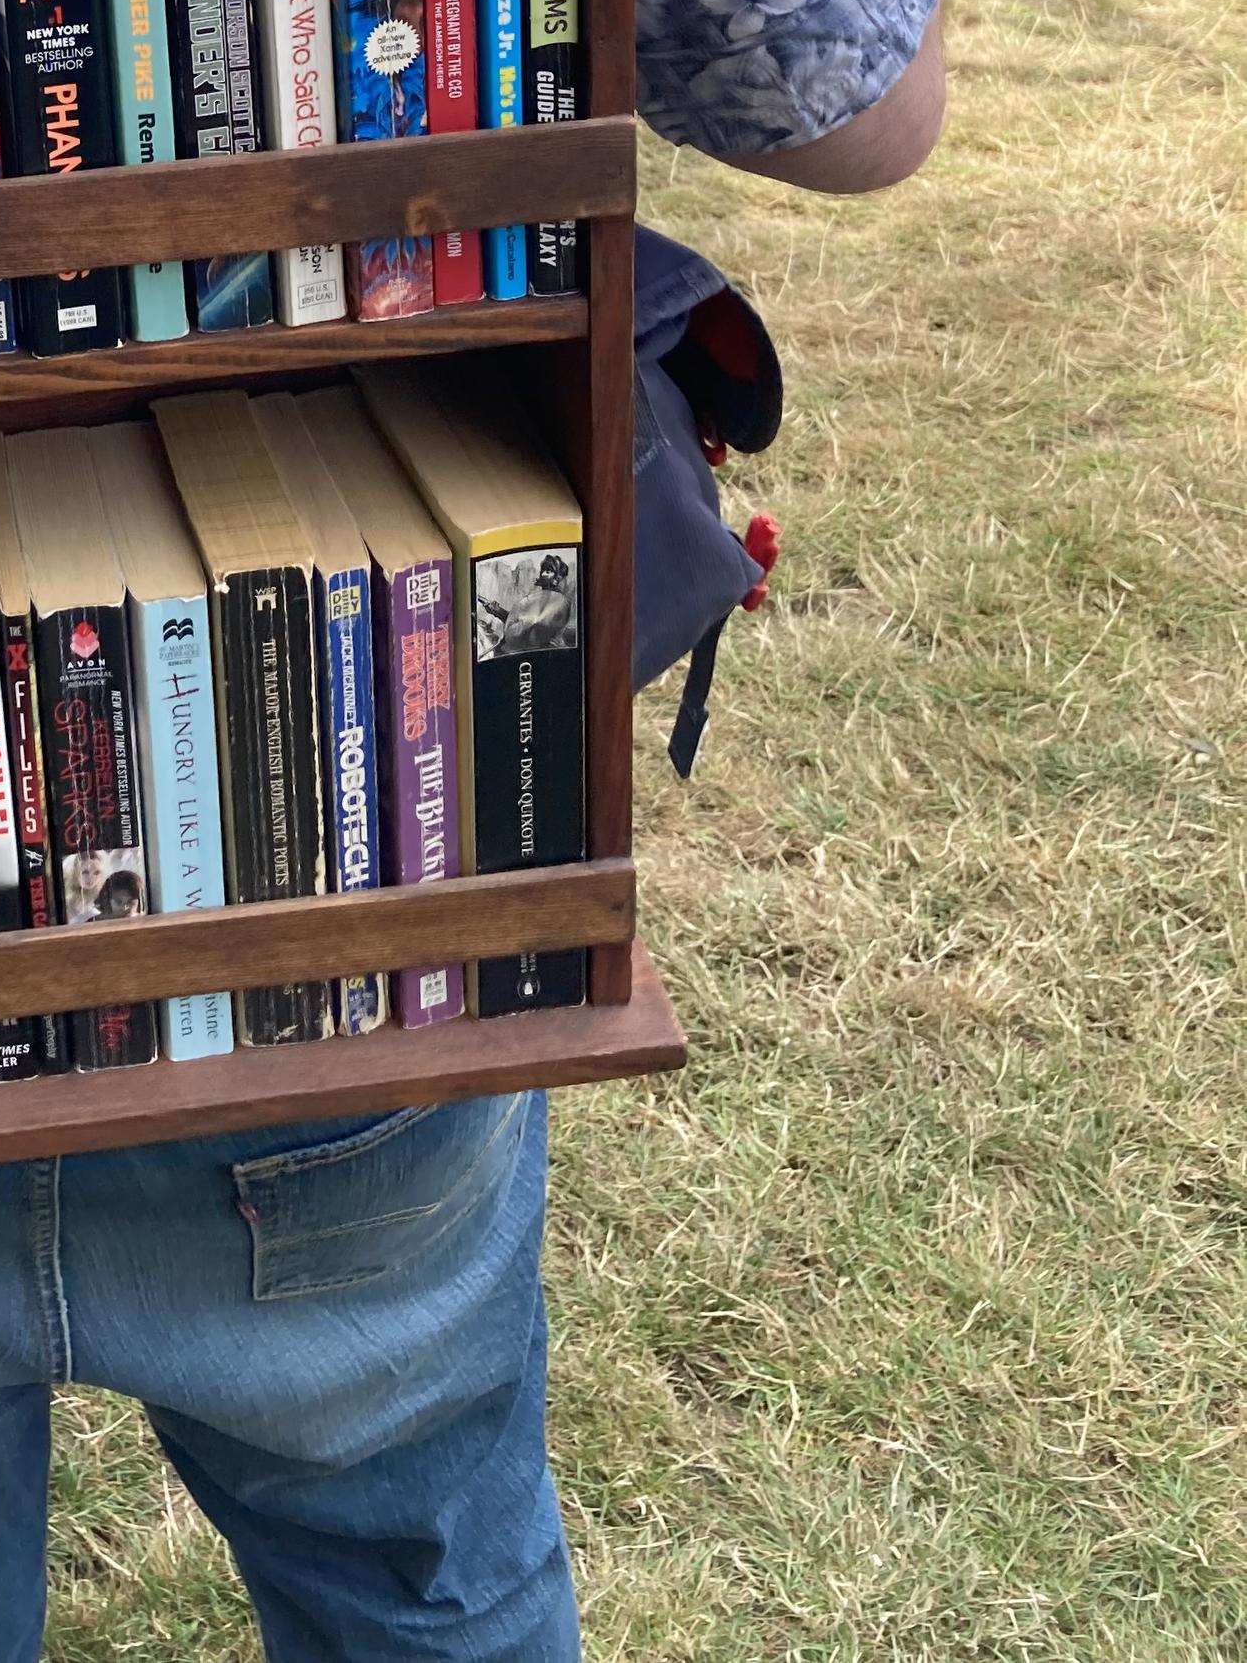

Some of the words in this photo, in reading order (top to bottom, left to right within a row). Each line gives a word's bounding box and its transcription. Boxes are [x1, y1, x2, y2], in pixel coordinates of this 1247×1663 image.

[434, 1, 442, 18] THE
[26, 28, 53, 40] NEW
[57, 24, 89, 35] YORK
[41, 37, 76, 49] TIMES
[292, 7, 316, 66] Who
[377, 33, 405, 44] all-new
[385, 25, 396, 33] An
[435, 20, 443, 62] JAMESON
[25, 47, 94, 64] BESTSELLING
[373, 52, 412, 65] adventure
[380, 44, 403, 53] Xanth
[447, 43, 461, 56] BY
[498, 30, 515, 59] Jr.
[37, 59, 83, 74] AUTHOR
[134, 44, 154, 101] PIKE
[436, 63, 444, 89] HEIRS
[448, 57, 462, 77] THE
[294, 70, 321, 121] Said
[449, 79, 462, 99] CEO
[536, 71, 554, 123] GUIDE
[558, 87, 575, 120] THE
[229, 70, 255, 138] SCOTT
[332, 587, 358, 604] DEL
[409, 575, 438, 593] DEL
[409, 589, 439, 606] REY
[333, 601, 359, 616] REY
[9, 626, 23, 638] THE
[7, 644, 28, 672] X
[67, 658, 106, 669] AVON
[262, 640, 277, 669] THE
[59, 672, 113, 683] PARANORMAL
[263, 670, 280, 714] MAJOR
[401, 634, 428, 742] BROOKS
[111, 690, 122, 707] NEW
[518, 661, 533, 744] CERVANTES
[112, 708, 125, 733] YORK
[161, 673, 200, 786] HUNGRY
[15, 680, 37, 834] FILES
[115, 733, 126, 758] TIMES
[266, 717, 285, 775] ENGLISH
[54, 698, 97, 846] SPARKS
[414, 744, 443, 798] THE
[519, 757, 533, 792] DON
[116, 759, 131, 813] BESTSELLING
[268, 778, 288, 846] ROMANTIC
[338, 725, 370, 887] ROBOTECH
[121, 814, 132, 846] AUTHOR
[178, 798, 199, 851] LIKE
[415, 801, 445, 874] BLACK
[516, 791, 535, 859] QUIXOTE
[181, 863, 200, 879] A
[273, 847, 289, 887] POETS
